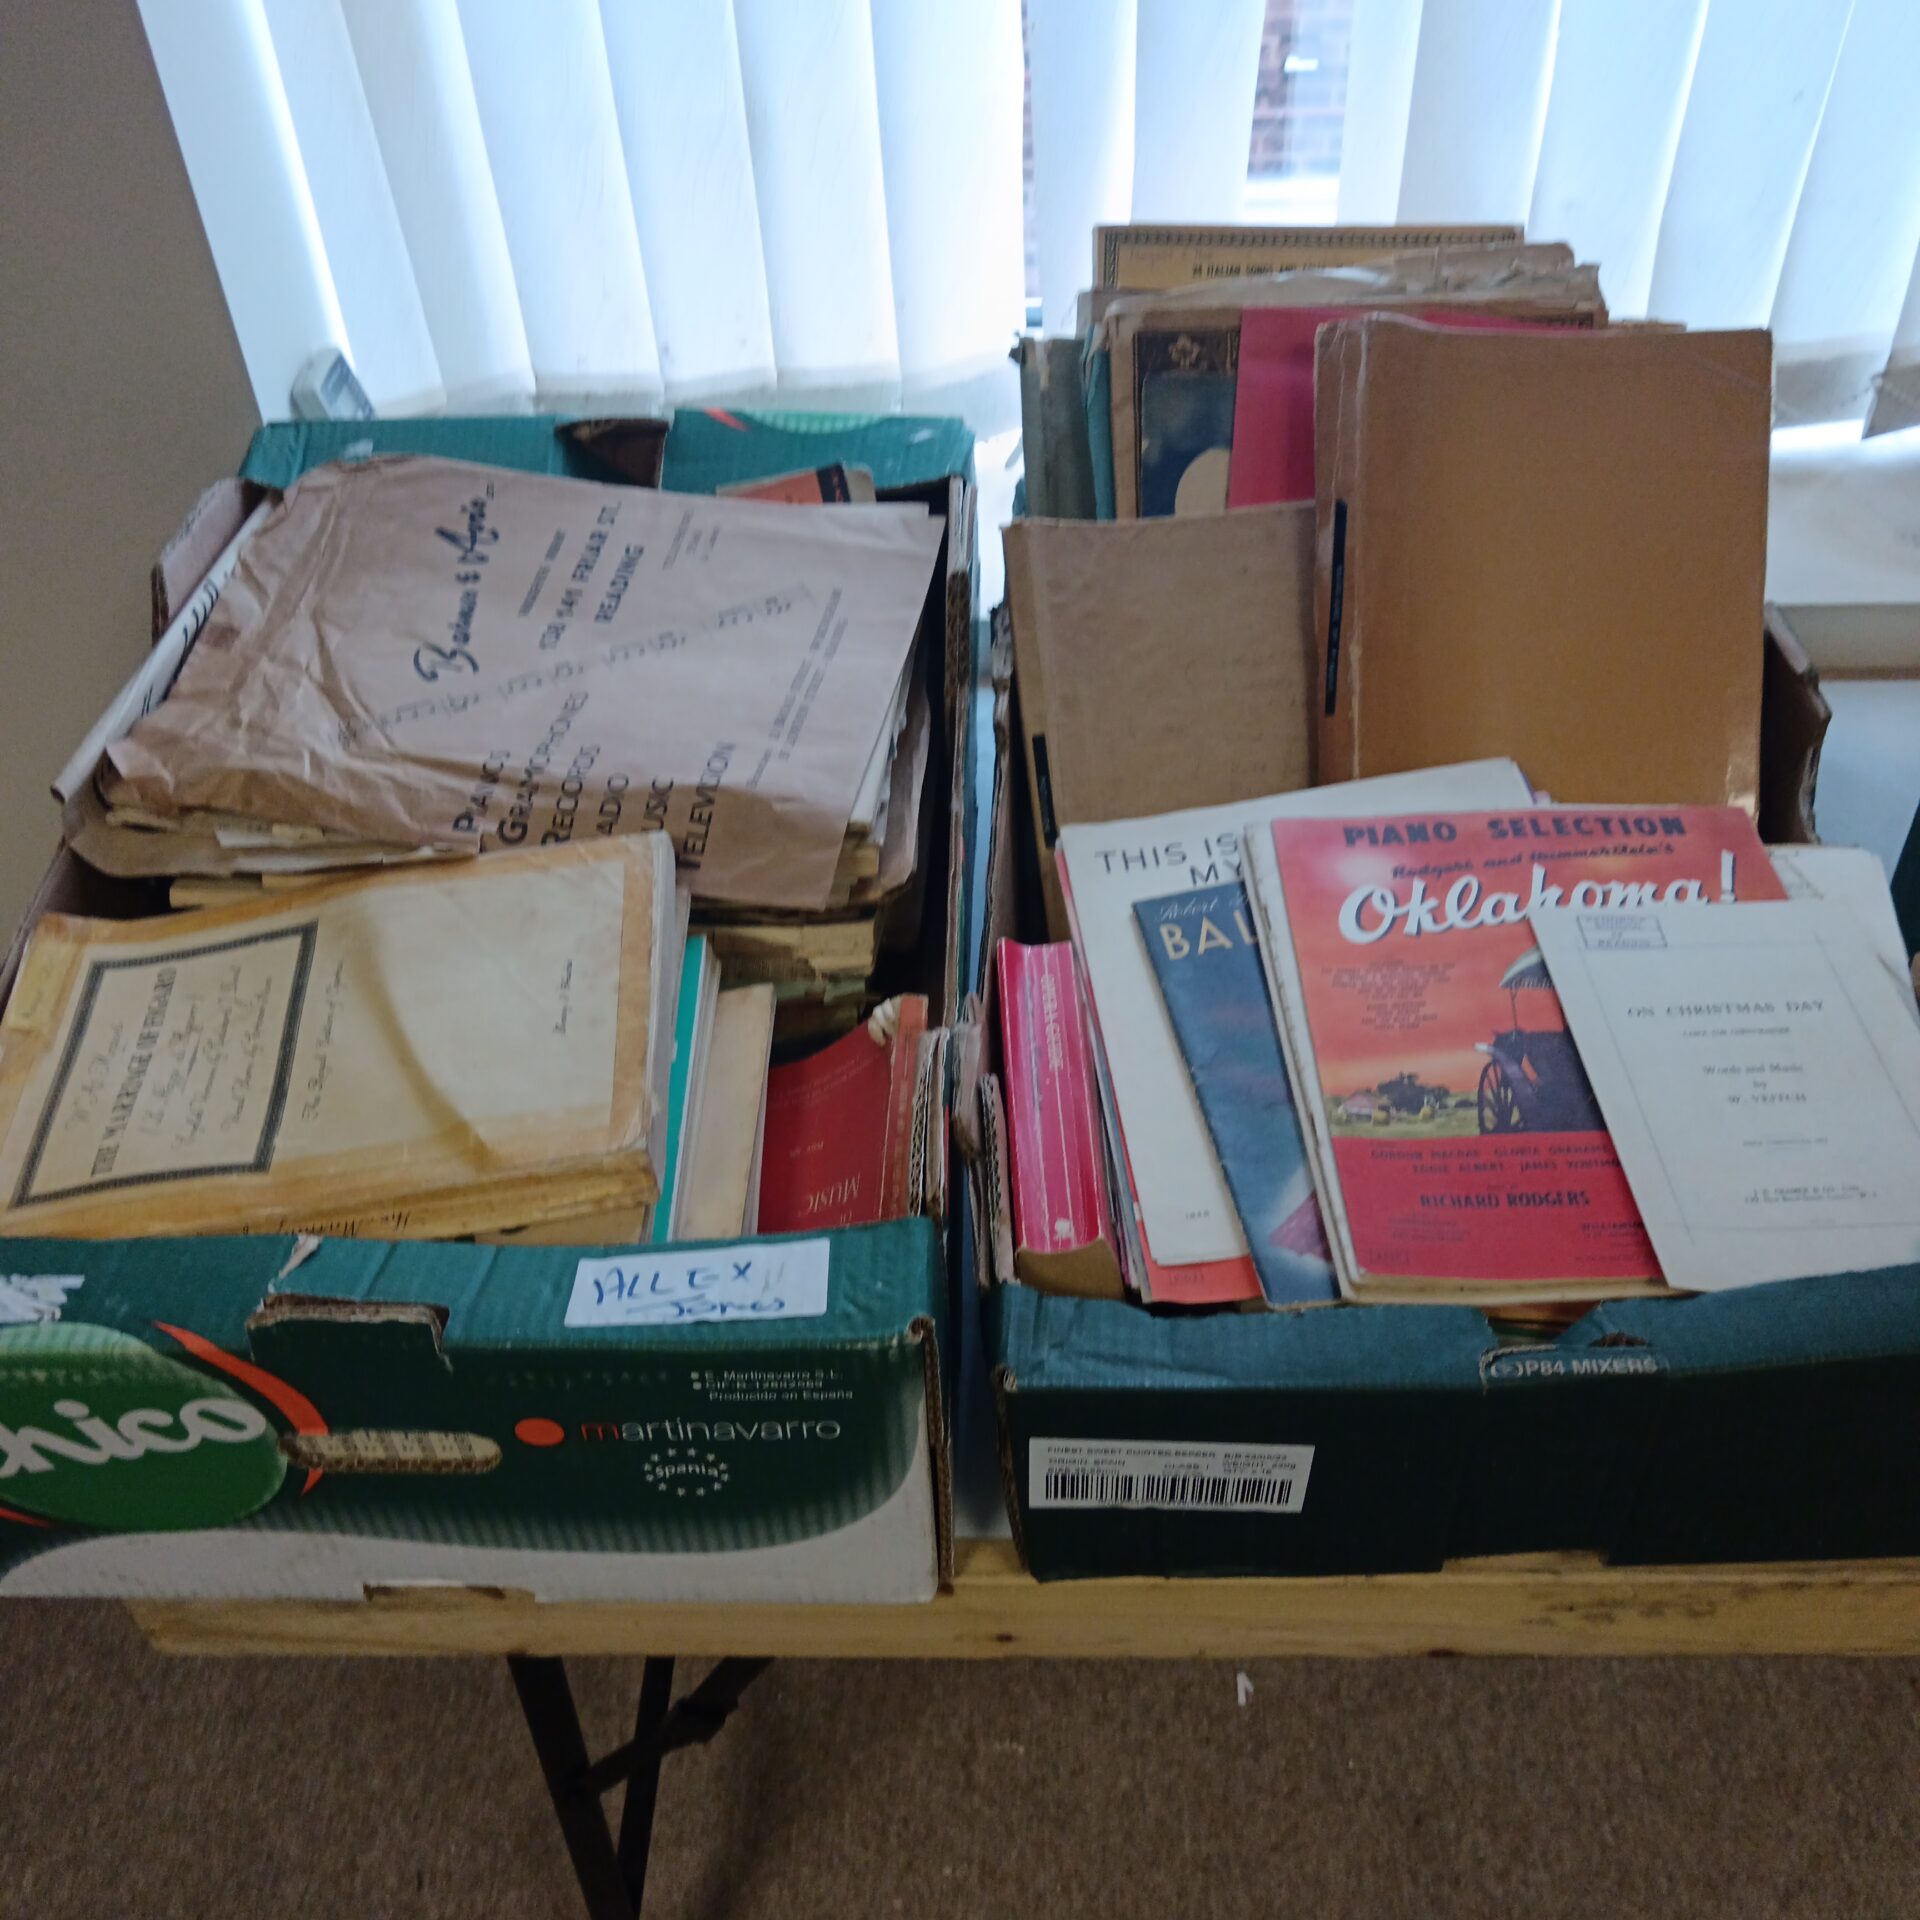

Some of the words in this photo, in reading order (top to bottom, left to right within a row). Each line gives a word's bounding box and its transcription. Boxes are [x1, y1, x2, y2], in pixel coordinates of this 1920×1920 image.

[594, 543, 645, 624] READING
[596, 772, 629, 835] ADIO
[641, 775, 674, 833] USIC
[676, 741, 736, 869] TELEVISION
[1343, 821, 1457, 848] PIANO
[1487, 815, 1687, 840] SELECTION
[1095, 841, 1187, 874] THIS
[1204, 832, 1238, 859] IS
[1190, 860, 1243, 887] MY
[1483, 853, 1522, 868] and
[1338, 848, 1737, 944] Oklahoma!
[144, 967, 177, 1027] FIGARO
[1628, 1006, 1654, 1017] ON
[1666, 1002, 1775, 1016] CHRISTMAS
[1785, 1000, 1823, 1012] DAY
[136, 1031, 160, 1050] OF
[102, 1053, 152, 1140] MARRIAGE
[91, 1143, 120, 1177] THE
[802, 1171, 861, 1214] MUSIC
[1420, 1193, 1500, 1208] RICHARD
[1507, 1190, 1590, 1207] RODGERS
[1572, 1356, 1658, 1376] MIXERS
[0, 1398, 267, 1478] nico
[580, 1416, 841, 1441] martinavarro
